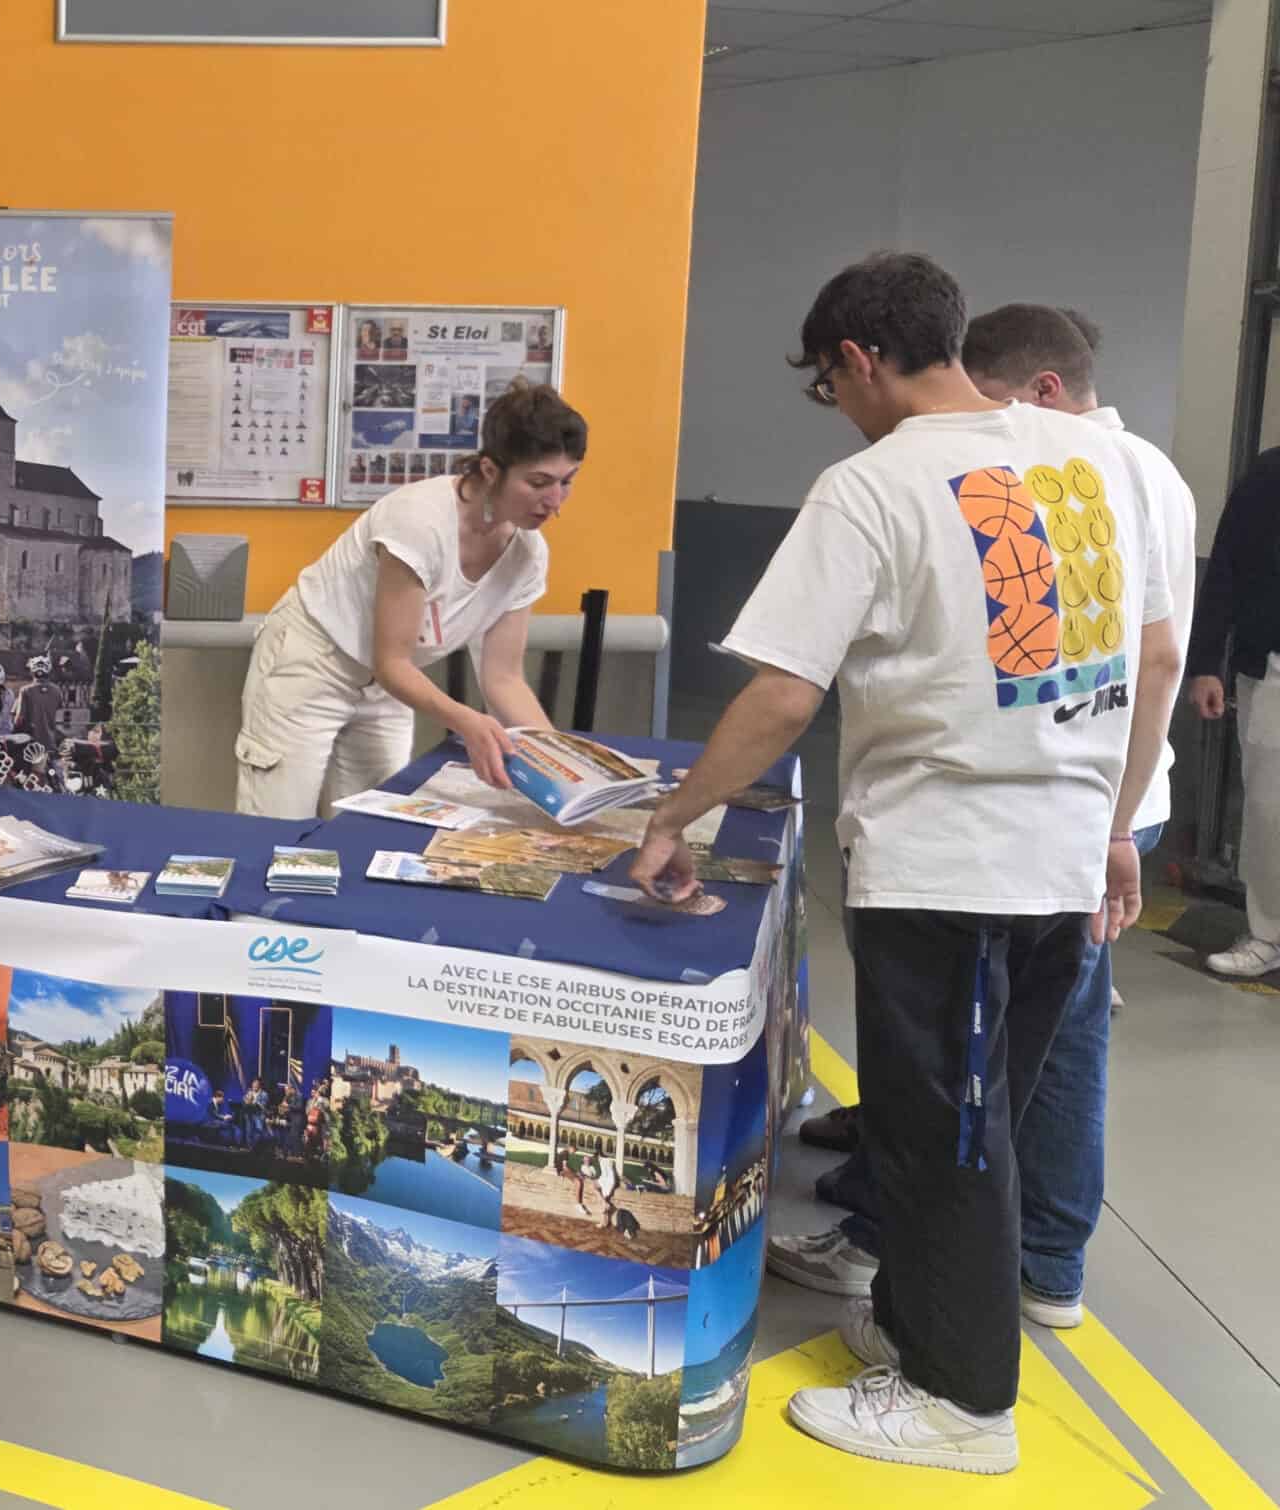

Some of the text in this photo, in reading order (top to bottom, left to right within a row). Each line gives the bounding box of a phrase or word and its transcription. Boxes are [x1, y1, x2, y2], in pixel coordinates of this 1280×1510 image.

[177, 319, 207, 337] cgt
[427, 325, 490, 341] St Eloi
[248, 934, 325, 964] cse
[407, 975, 429, 991] LA
[432, 979, 552, 1009] DESTINATION
[556, 997, 657, 1024] OCCITANIE
[660, 1012, 701, 1031] SUD
[705, 1019, 729, 1034] DE
[440, 963, 489, 982] AVEC
[492, 970, 513, 985] LE
[517, 973, 553, 991] CSE
[556, 979, 627, 1001] AIRBUS
[630, 990, 745, 1014] OPÉRATIONS
[447, 998, 499, 1019] VIVEZ
[503, 1007, 529, 1023] DE
[532, 1011, 654, 1042] FABULEUSES
